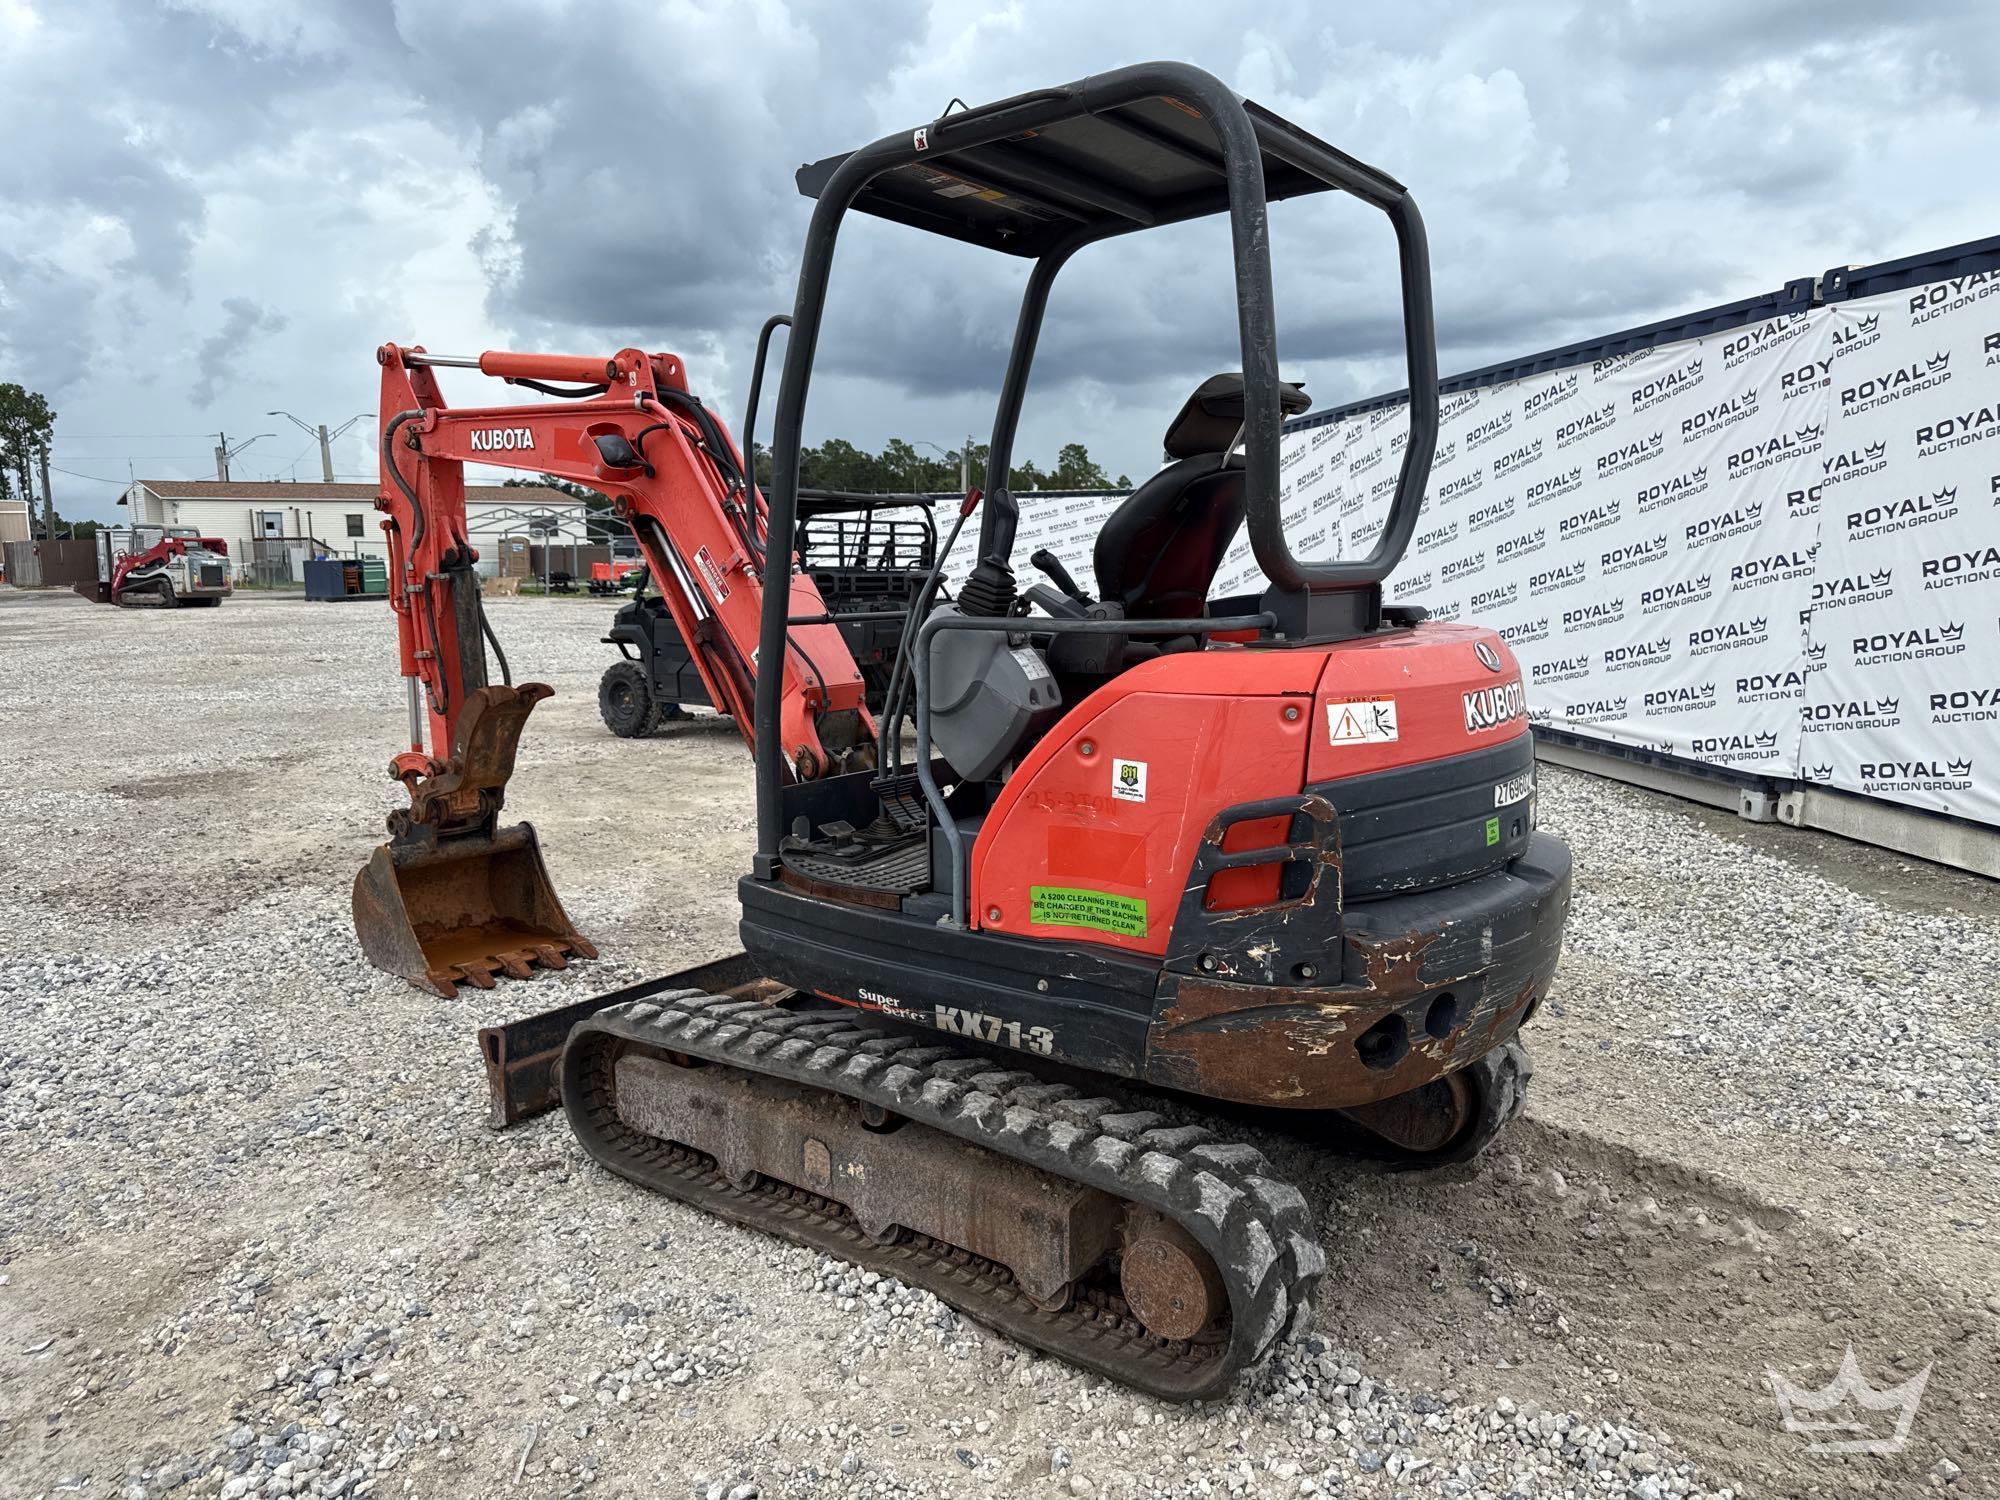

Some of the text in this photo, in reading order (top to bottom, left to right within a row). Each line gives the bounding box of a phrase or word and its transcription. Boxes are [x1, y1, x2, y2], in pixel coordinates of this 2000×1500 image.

[1912, 293, 1975, 327] AUCTION
[1724, 319, 1788, 360] ROYAL
[1725, 323, 1810, 370] AUCTION GROUP
[1837, 334, 1880, 357] GROUP
[1594, 361, 1627, 384] AUCTION
[1629, 347, 1655, 365] GROUP
[1782, 357, 1833, 390] ROY
[1632, 370, 1687, 404] ROYAL
[1633, 375, 1703, 414] AUCTION GROUP
[1842, 364, 1925, 406] ROYAL
[1843, 372, 1951, 418] AUCTION GROUP
[1525, 382, 1566, 412] ROYAL
[1526, 388, 1578, 420] AUCTION GROUP
[1557, 412, 1602, 440] ROYAL
[1682, 399, 1741, 434] ROYAL
[1683, 406, 1759, 444] AUCTION GROUP
[1917, 404, 2000, 445] ROYA
[471, 428, 535, 450] KUBOTA
[1312, 426, 1334, 446] ROYAL
[1467, 418, 1501, 444] ROYAL
[1558, 418, 1616, 450] AUCTION GROUP
[1598, 440, 1648, 470] ROYAL
[1728, 434, 1795, 470] ROYAL
[1918, 431, 1982, 458] AUCTION
[1350, 454, 1375, 473] ROYAL
[1494, 446, 1531, 472] ROYAL
[1495, 452, 1542, 480] AUCTION GROUP
[1599, 448, 1663, 480] AUCTION GROUP
[1729, 443, 1821, 480] AUCTION GROUP
[1297, 468, 1319, 487] ROYAL
[1843, 461, 1887, 480] GROUP
[1440, 476, 1472, 498] ROYAL
[1527, 474, 1569, 500] ROYAL
[1528, 482, 1582, 508] AUCTION GROUP
[1638, 475, 1692, 504] ROYAL
[1065, 502, 1087, 511] ROYAL
[1313, 491, 1335, 509] ROYAL
[1639, 483, 1708, 514] AUCTION GROUP
[1029, 511, 1052, 519] ROYAL
[1469, 502, 1504, 525] ROYAL
[1560, 508, 1606, 532] ROYAL
[1848, 496, 1932, 530] ROYAL
[1049, 522, 1071, 531] ROYAL
[1351, 522, 1376, 541] ROYAL
[1561, 516, 1620, 541] AUCTION GROUP
[1686, 510, 1744, 540] ROYAL
[1687, 520, 1761, 550] AUCTION GROUP
[1849, 508, 1958, 542] AUCTION GROUP
[1034, 541, 1057, 549] ROYAL
[1070, 533, 1093, 542] ROYAL
[1298, 534, 1319, 549] ROYAL
[1418, 527, 1449, 547] ROYAL
[1497, 534, 1534, 556] ROYAL
[1602, 541, 1652, 566] ROYAL
[1603, 551, 1668, 576] AUCTION GROUP
[1922, 549, 2000, 577] ROYA
[705, 560, 723, 586] DANGER
[1442, 557, 1475, 576] ROYAL
[1530, 567, 1572, 588] ROYAL
[1731, 552, 1806, 581] ROYAL
[1394, 577, 1423, 593] ROYAL
[1530, 576, 1585, 596] AUCTION GROUP
[1733, 567, 1815, 592] AUCTION GRO
[1812, 576, 1869, 599] OYAL
[1924, 570, 1989, 590] AUCTION
[1471, 588, 1506, 606] ROYAL
[1642, 581, 1695, 605] ROYAL
[1643, 591, 1712, 614] AUCTION GROUP
[1849, 589, 1893, 605] GROUP
[1563, 604, 1610, 624] ROYAL
[1564, 614, 1624, 633] AUCTION GROUP
[1500, 621, 1537, 640] ROYAL
[1526, 632, 1549, 643] GROUP
[1690, 623, 1749, 646] ROYAL
[1853, 629, 1939, 654] ROYAL
[1605, 643, 1655, 663] ROYAL
[1690, 635, 1768, 656] AUCTION GROUP
[1855, 644, 1965, 666] AUCTION GROUP
[1533, 660, 1576, 676] ROYAL
[1606, 654, 1671, 672] AUCTION GROUP
[1534, 670, 1589, 685] AUCTION GROUP
[1463, 682, 1525, 729] KUBOTA
[1645, 687, 1699, 706] ROYAL
[1738, 691, 1791, 704] AUCTION
[1566, 702, 1613, 716] ROYAL
[1600, 713, 1627, 722] GROUP
[1646, 700, 1716, 716] AUCTION GROUP
[1802, 701, 1875, 720] ROYAL
[1932, 711, 1997, 723] AUCTION
[1802, 718, 1900, 733] AUCTION GROUP
[1692, 736, 1754, 752] ROYAL
[1694, 750, 1779, 762] AUCTION GROUP
[1122, 765, 1137, 779] 811
[1860, 762, 1945, 779] ROYAL
[1863, 782, 1972, 792] AUCTION GROUP
[1047, 903, 1085, 911] CHARGED
[1096, 907, 1110, 916] THIS
[1112, 910, 1144, 922] MACHINE
[1067, 895, 1104, 905] CLEANING
[1107, 900, 1119, 908] FEE
[1121, 903, 1137, 912] WILL
[1071, 913, 1110, 925] RETURNED
[1113, 919, 1135, 930] CLEAN
[858, 988, 900, 1007] Super
[935, 1004, 1055, 1055] KX71-3
